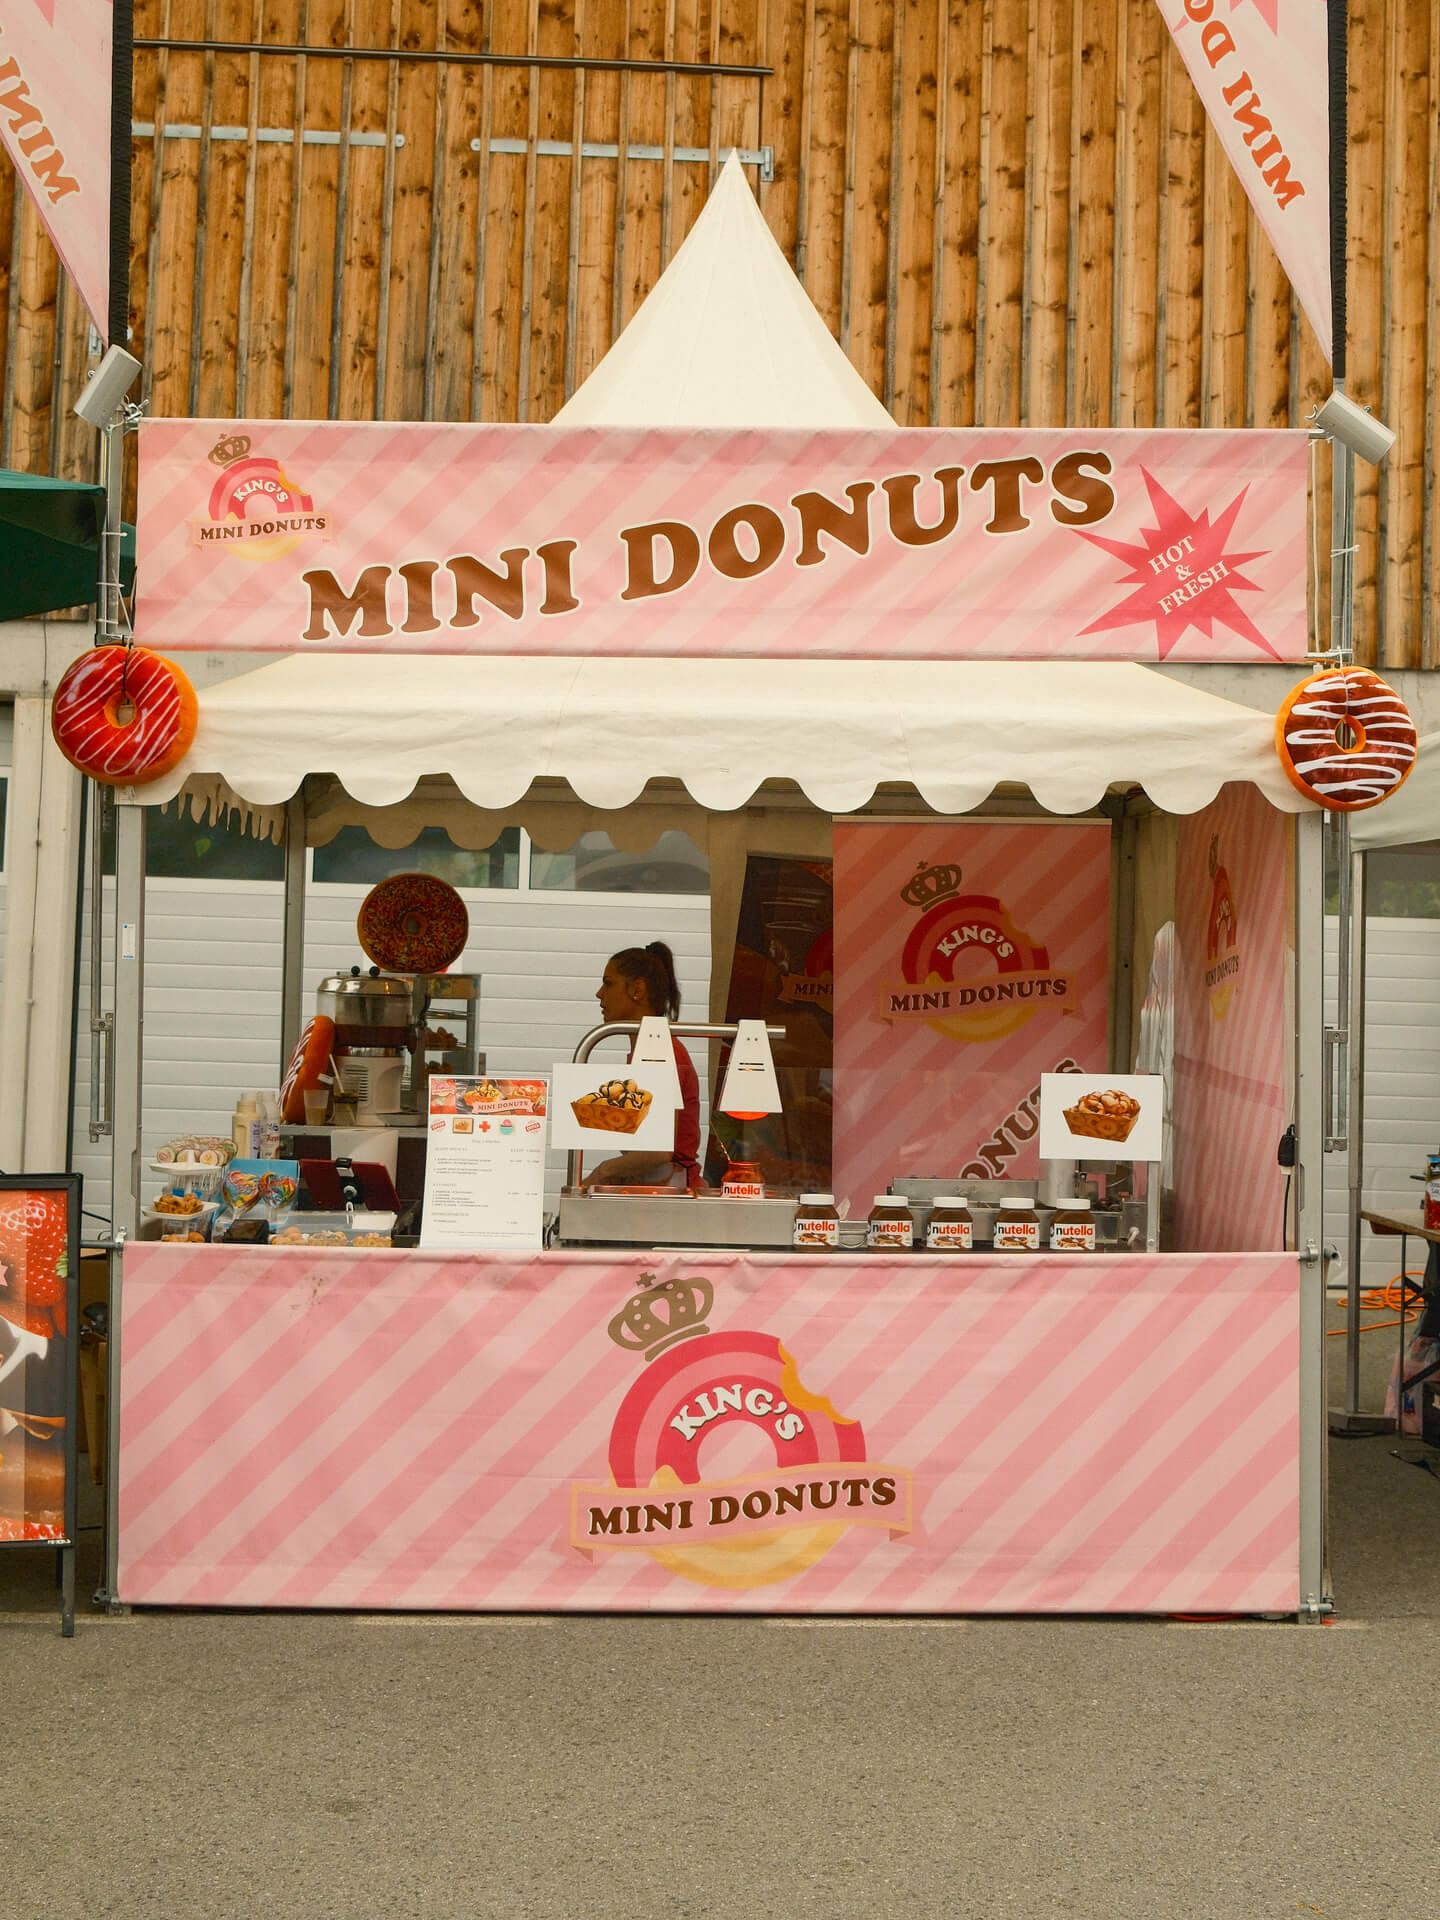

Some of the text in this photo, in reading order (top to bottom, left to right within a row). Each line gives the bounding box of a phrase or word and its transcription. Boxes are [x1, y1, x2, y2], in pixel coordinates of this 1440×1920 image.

[233, 479, 289, 503] KING'S
[200, 517, 326, 540] MINI DONUTS
[301, 451, 1116, 641] MINI DONUTS
[1148, 535, 1196, 575] HOT
[1175, 564, 1195, 581] &
[1157, 560, 1231, 615] FRESH
[937, 924, 1015, 959] KING'S
[890, 978, 1067, 1012] MINI DONUTS
[478, 1100, 529, 1111] MINI DONUTS
[723, 1182, 761, 1195] nutella
[797, 1221, 836, 1232] nutella
[872, 1222, 911, 1233] nutella
[932, 1223, 970, 1235] nutella
[998, 1224, 1036, 1235] nutella
[1056, 1224, 1093, 1236] nutella
[670, 1383, 804, 1442] KING'S
[588, 1477, 897, 1535] MINI DONUTS
